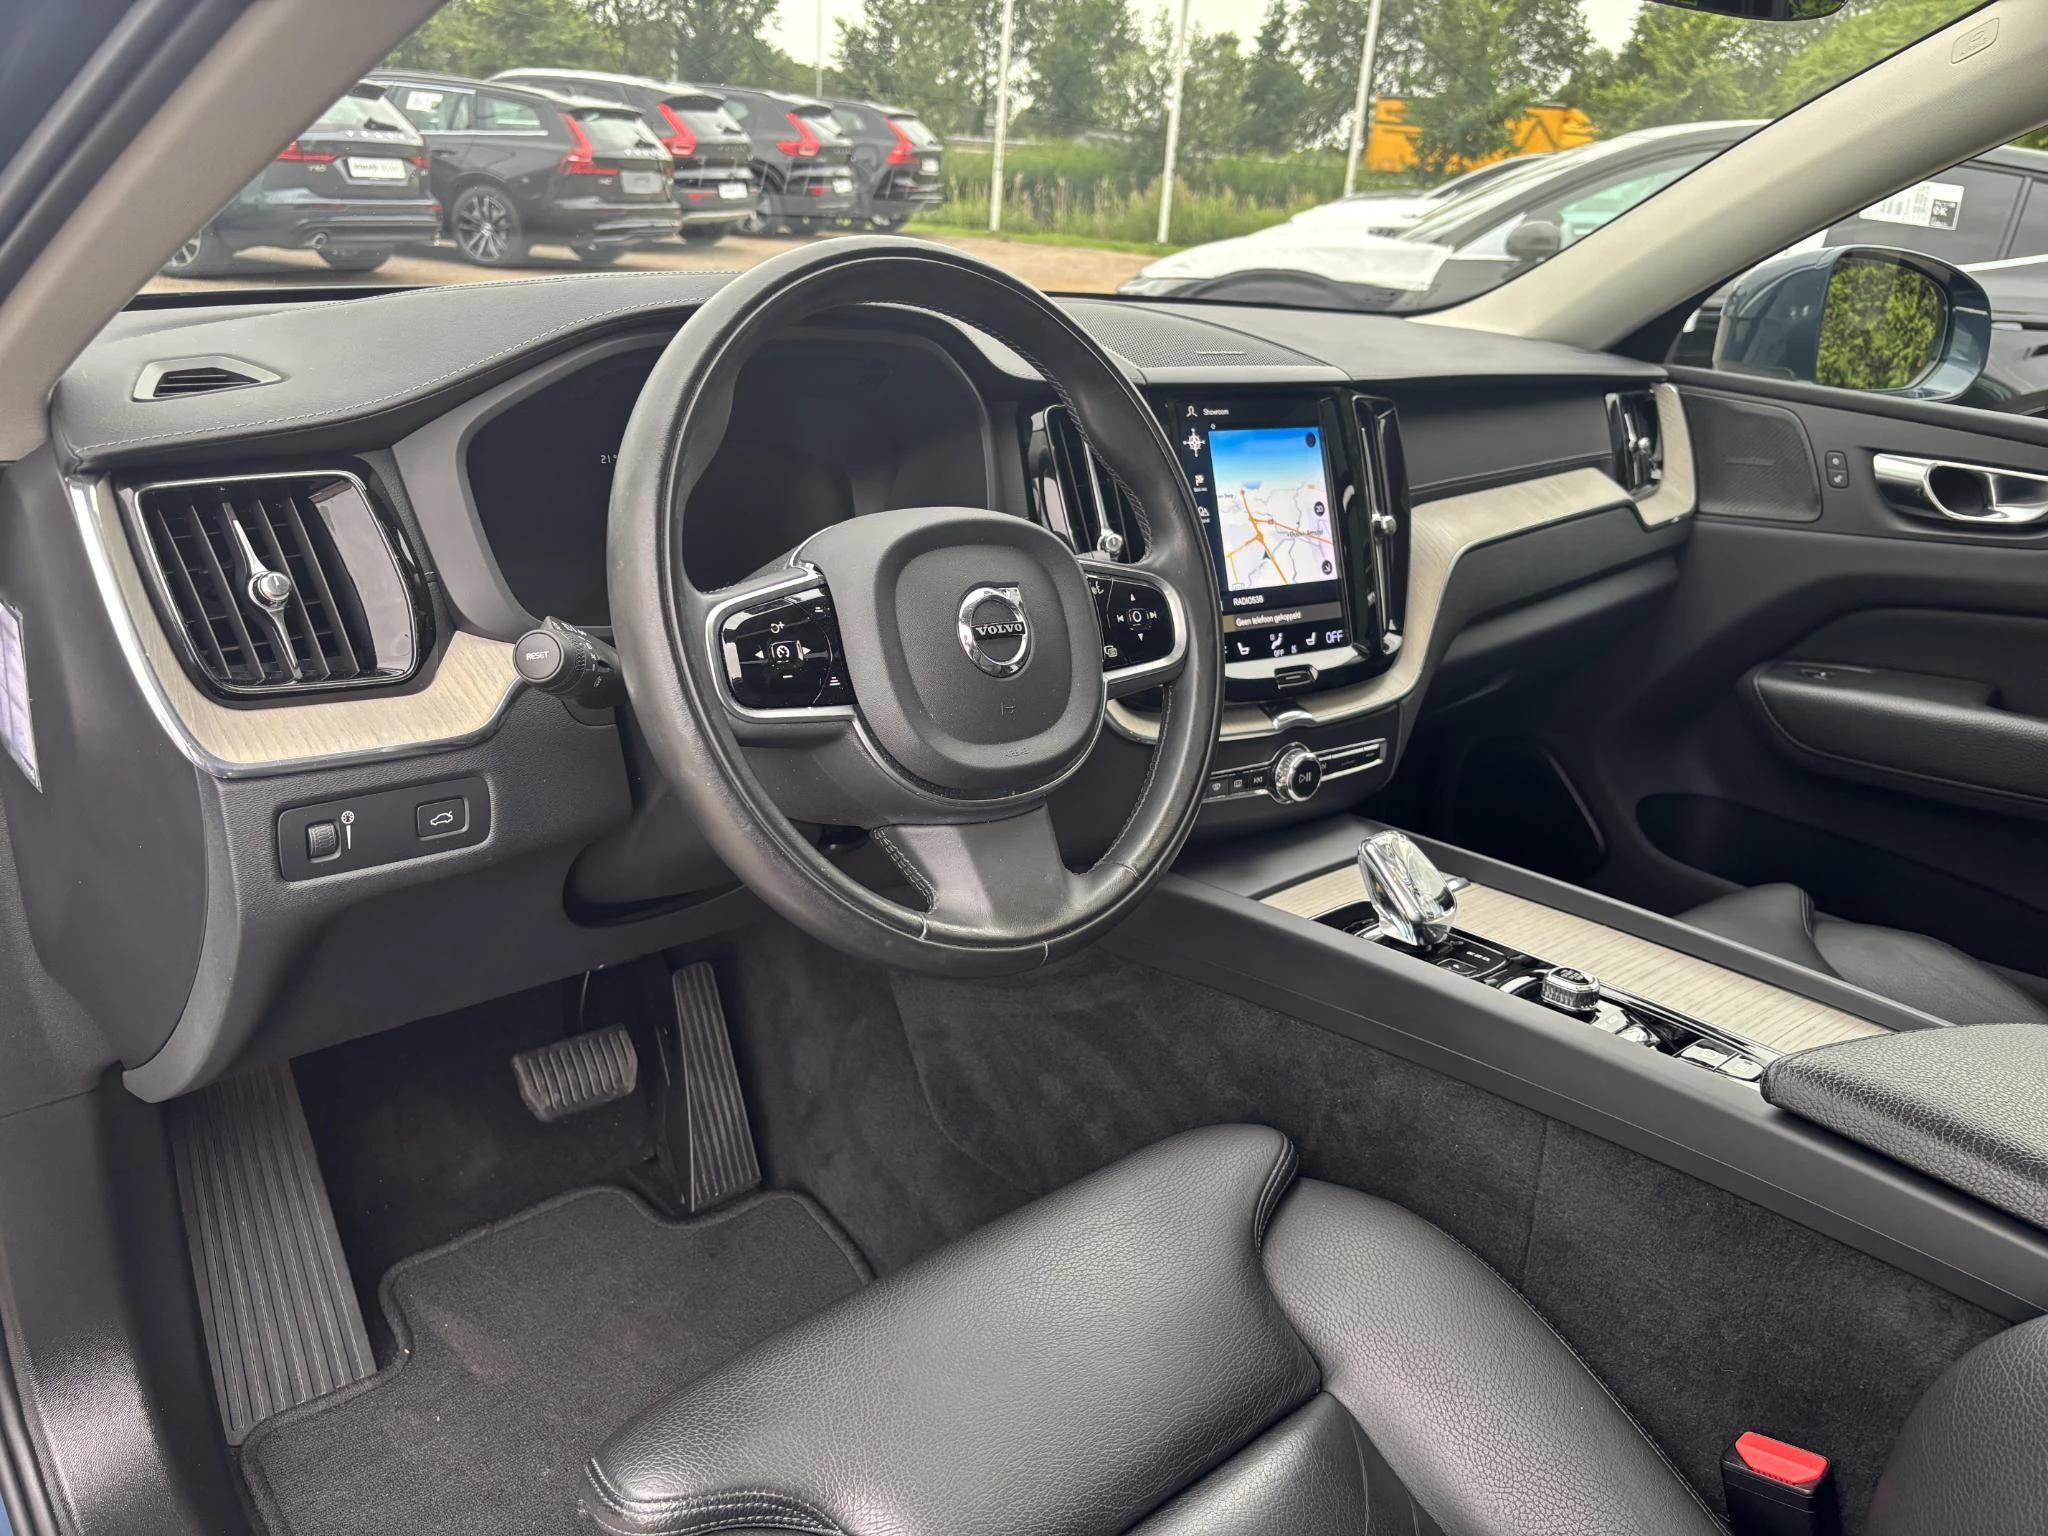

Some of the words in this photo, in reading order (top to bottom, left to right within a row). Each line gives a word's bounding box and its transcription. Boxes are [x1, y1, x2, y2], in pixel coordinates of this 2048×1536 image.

[1235, 617, 1252, 627] Geen
[1251, 614, 1274, 624] telefoon
[975, 623, 1023, 636] VOLVO
[1325, 630, 1343, 644] OFF
[526, 650, 549, 661] RESET
